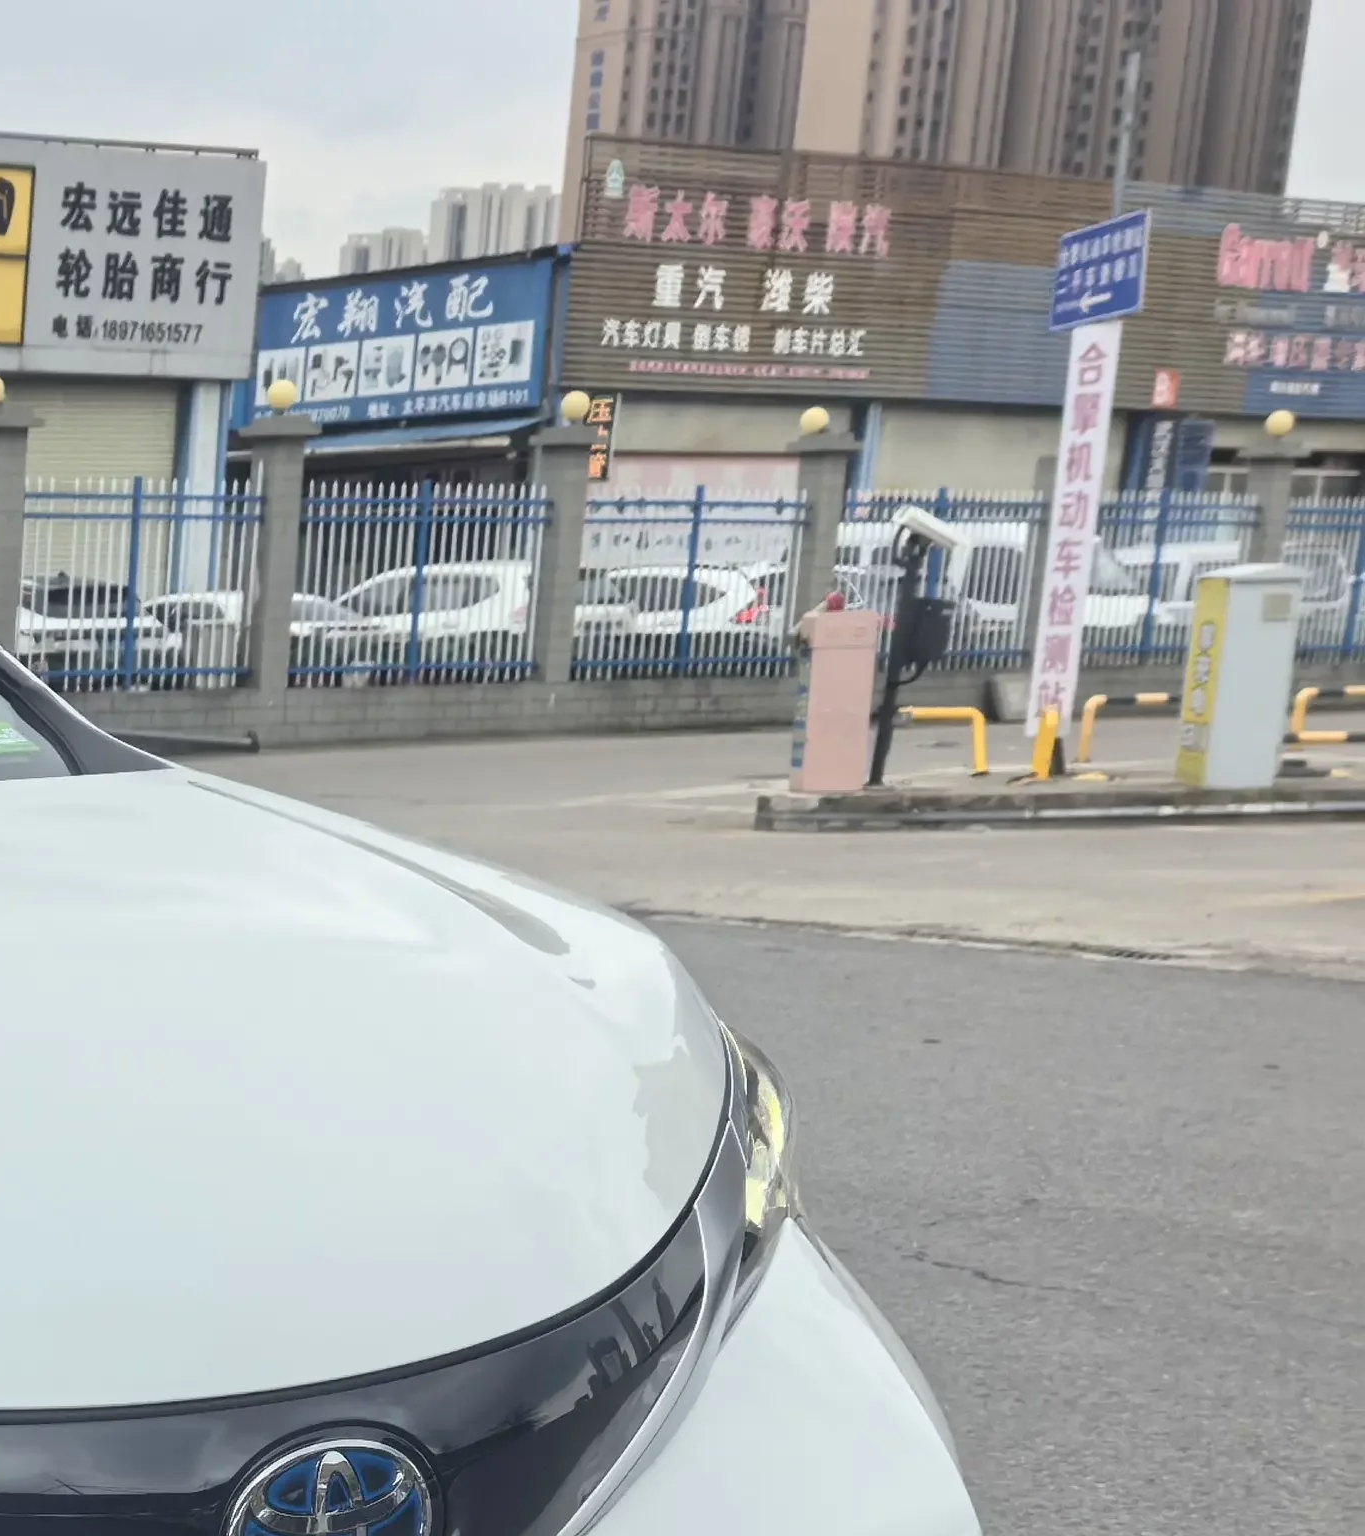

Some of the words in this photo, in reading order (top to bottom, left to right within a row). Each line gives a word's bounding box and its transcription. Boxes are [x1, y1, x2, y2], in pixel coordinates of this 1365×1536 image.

[59, 181, 235, 244] 宏远佳通
[622, 183, 731, 246] 斯太尔
[55, 247, 233, 306] 轮胎商行
[651, 263, 728, 311] 重汽
[759, 267, 835, 316] 潍柴
[289, 273, 494, 345] 宏翔汽配
[600, 318, 682, 350] 汽车灯具
